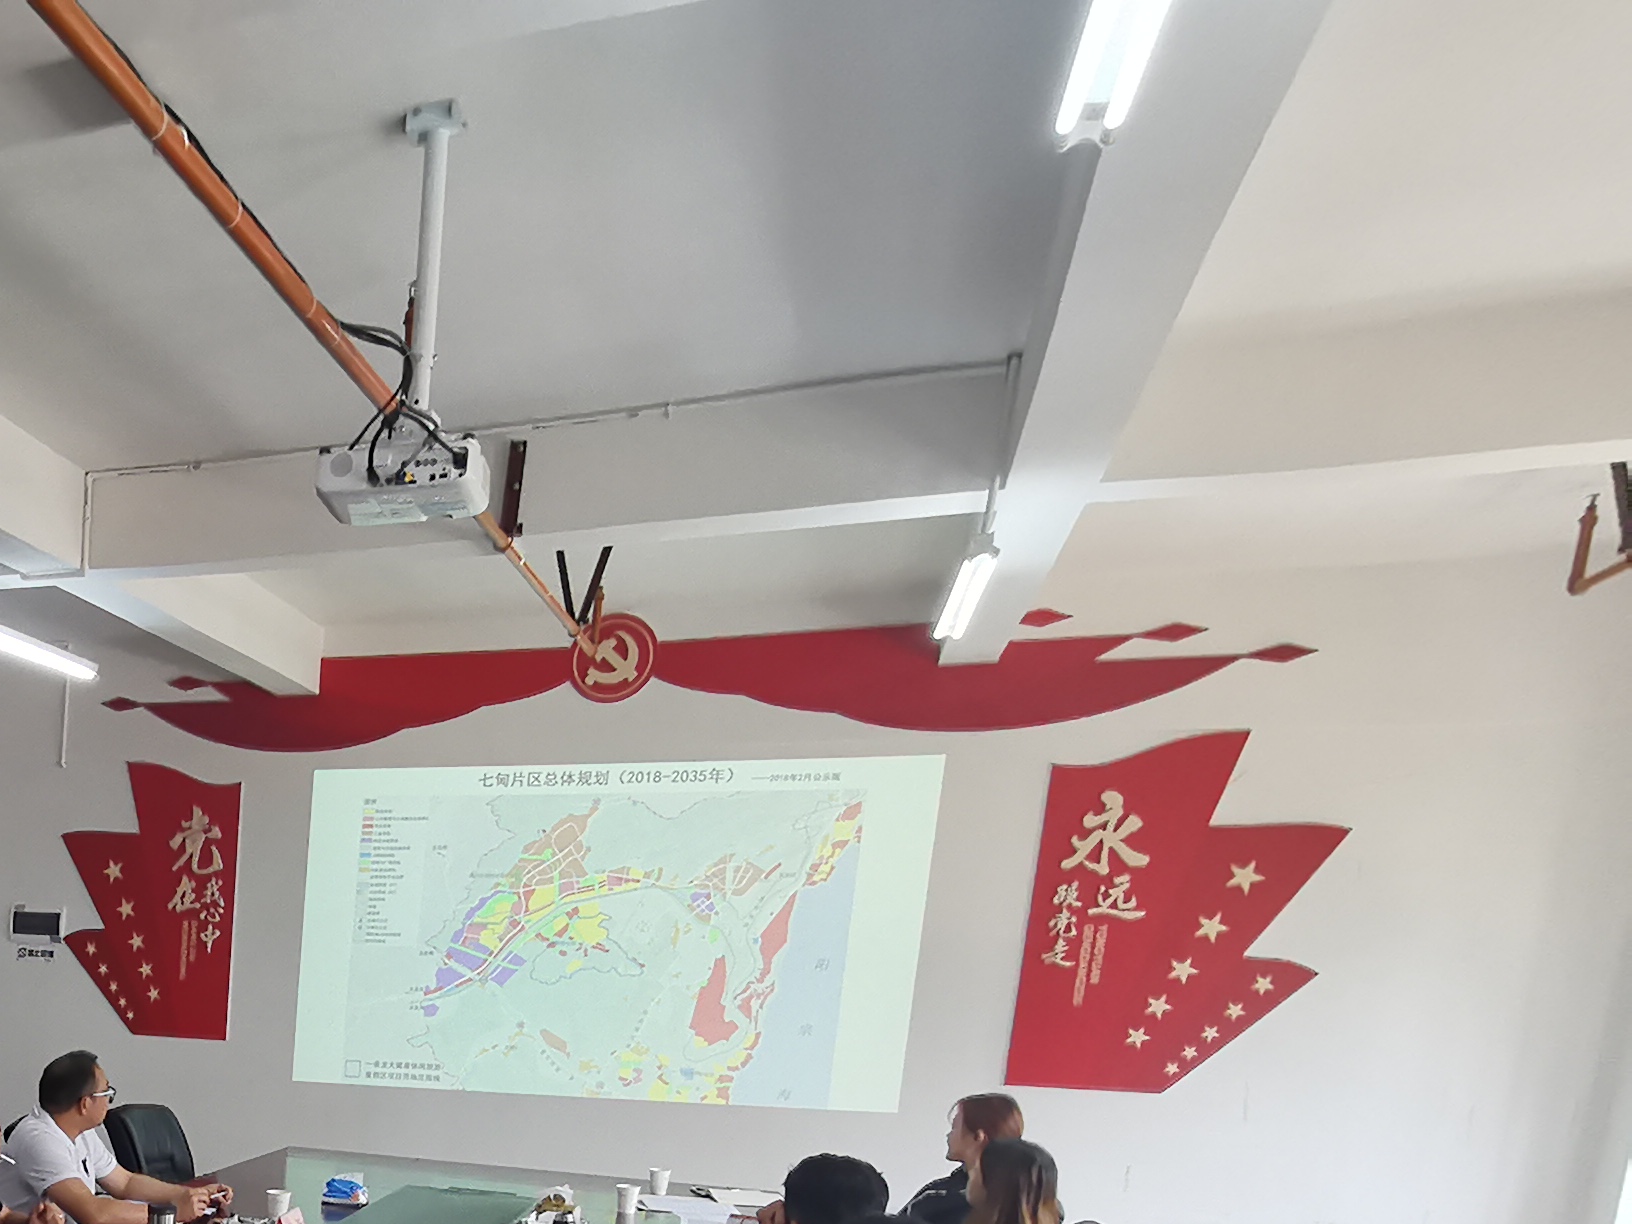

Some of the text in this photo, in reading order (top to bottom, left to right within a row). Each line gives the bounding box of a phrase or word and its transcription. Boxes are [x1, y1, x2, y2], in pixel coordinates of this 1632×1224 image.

[1059, 790, 1151, 921] 永远
[1041, 880, 1083, 968] 跟党走
